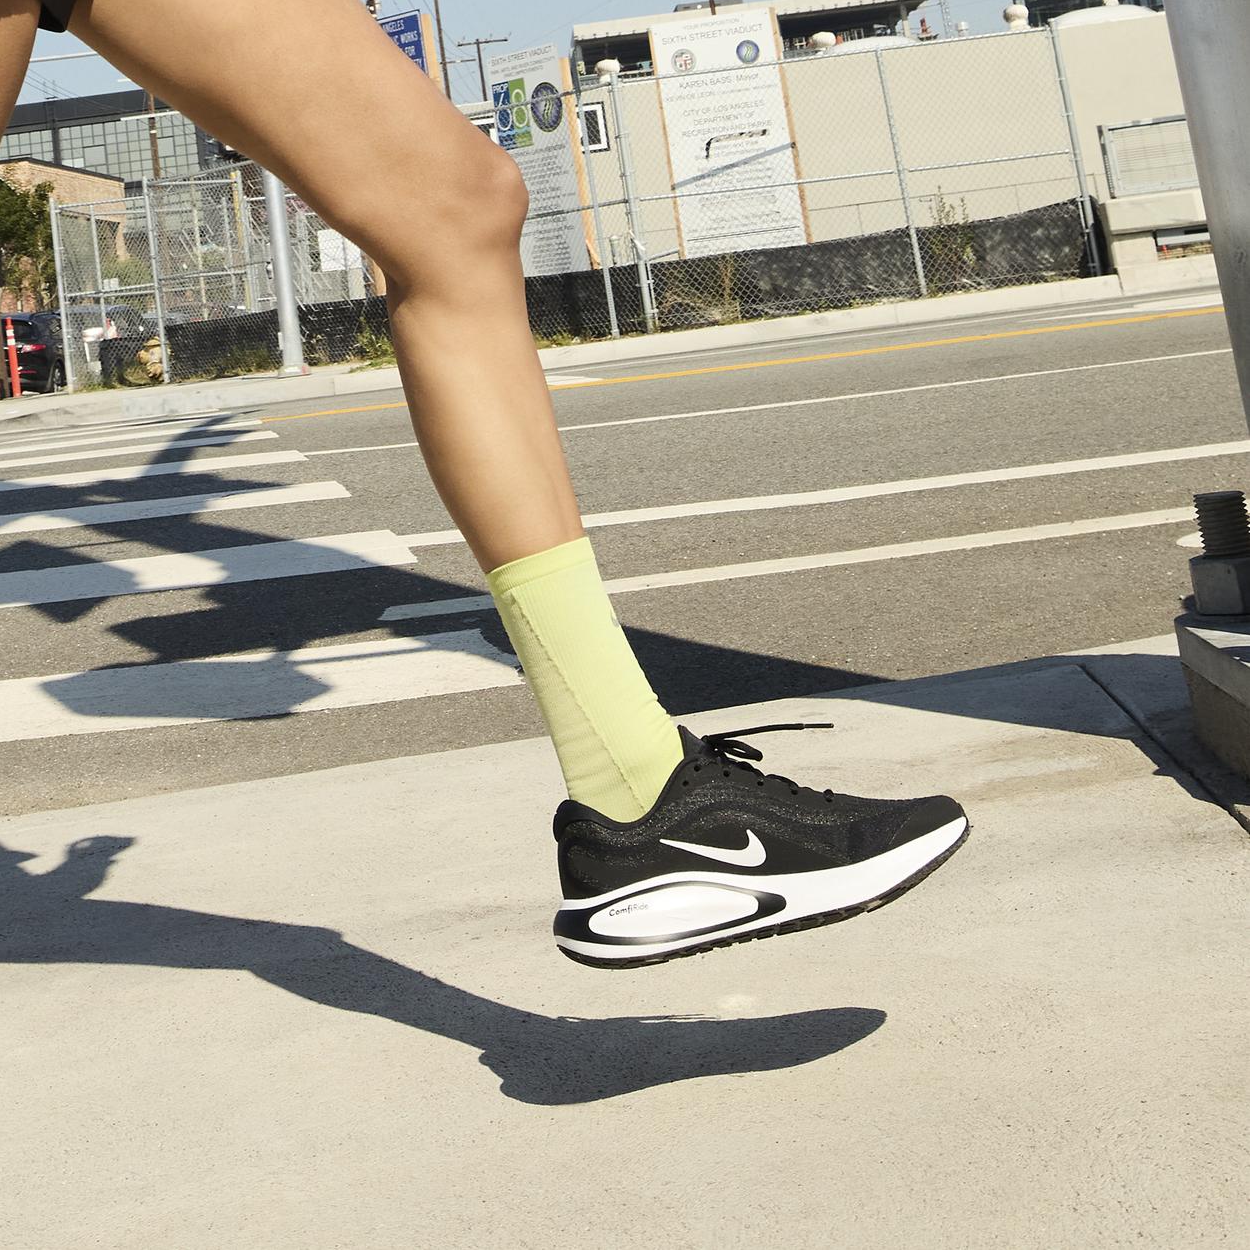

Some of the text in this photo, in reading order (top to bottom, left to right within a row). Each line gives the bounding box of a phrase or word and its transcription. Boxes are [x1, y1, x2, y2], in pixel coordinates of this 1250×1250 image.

[662, 23, 763, 45] SIXTH STREET VIADUCT
